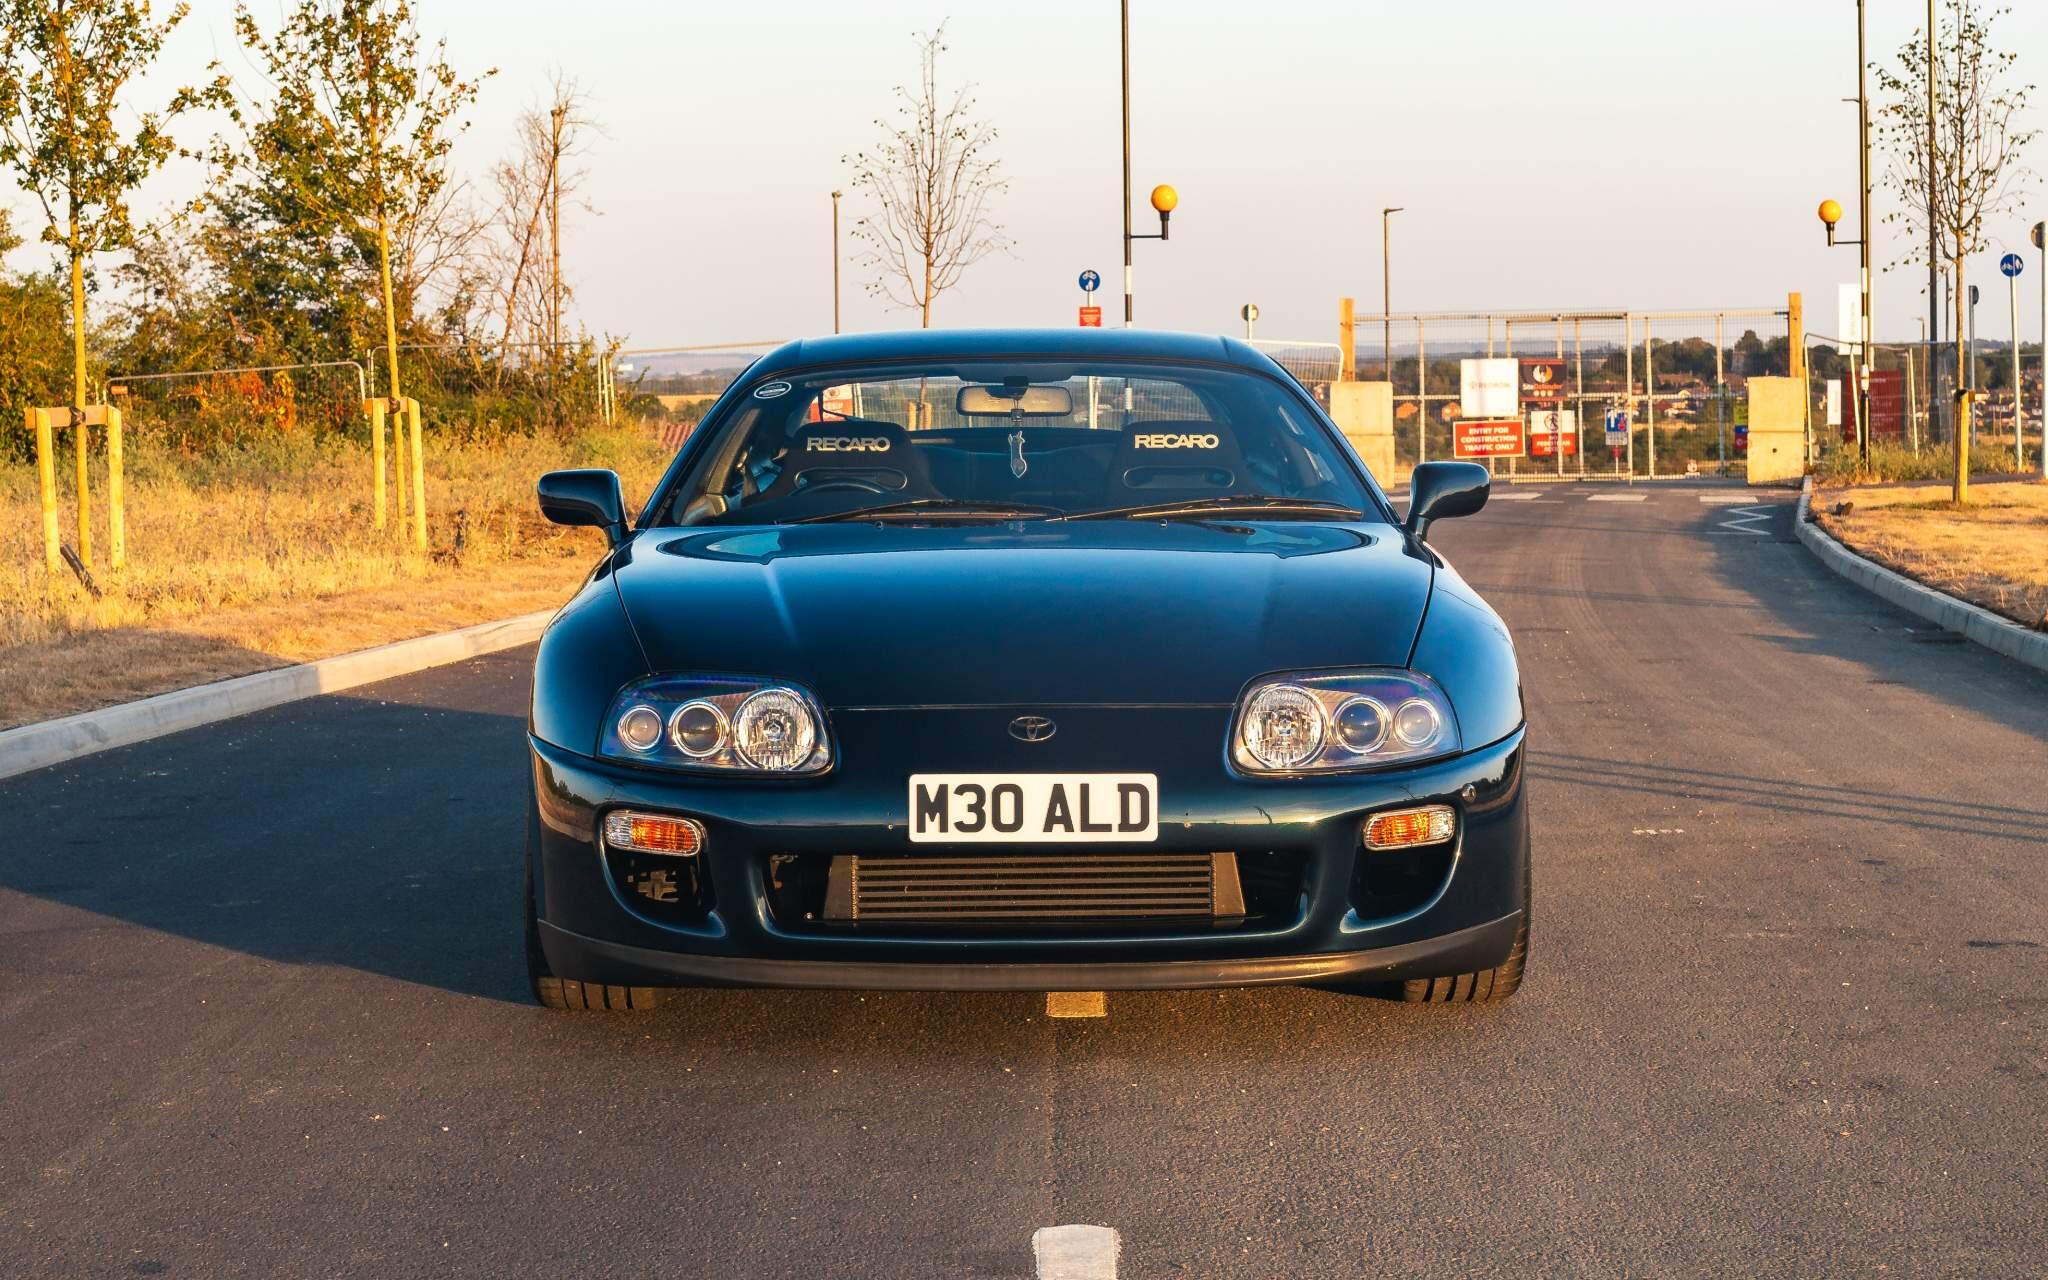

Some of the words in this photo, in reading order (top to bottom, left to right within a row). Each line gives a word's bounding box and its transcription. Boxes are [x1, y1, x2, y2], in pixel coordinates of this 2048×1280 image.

[1469, 427, 1492, 435] ENTRY
[806, 436, 891, 452] RECARO
[1134, 433, 1220, 449] RECARO
[1460, 435, 1518, 444] CONSTRUCTION
[916, 783, 1024, 833] M30
[1042, 783, 1150, 833] ALD
